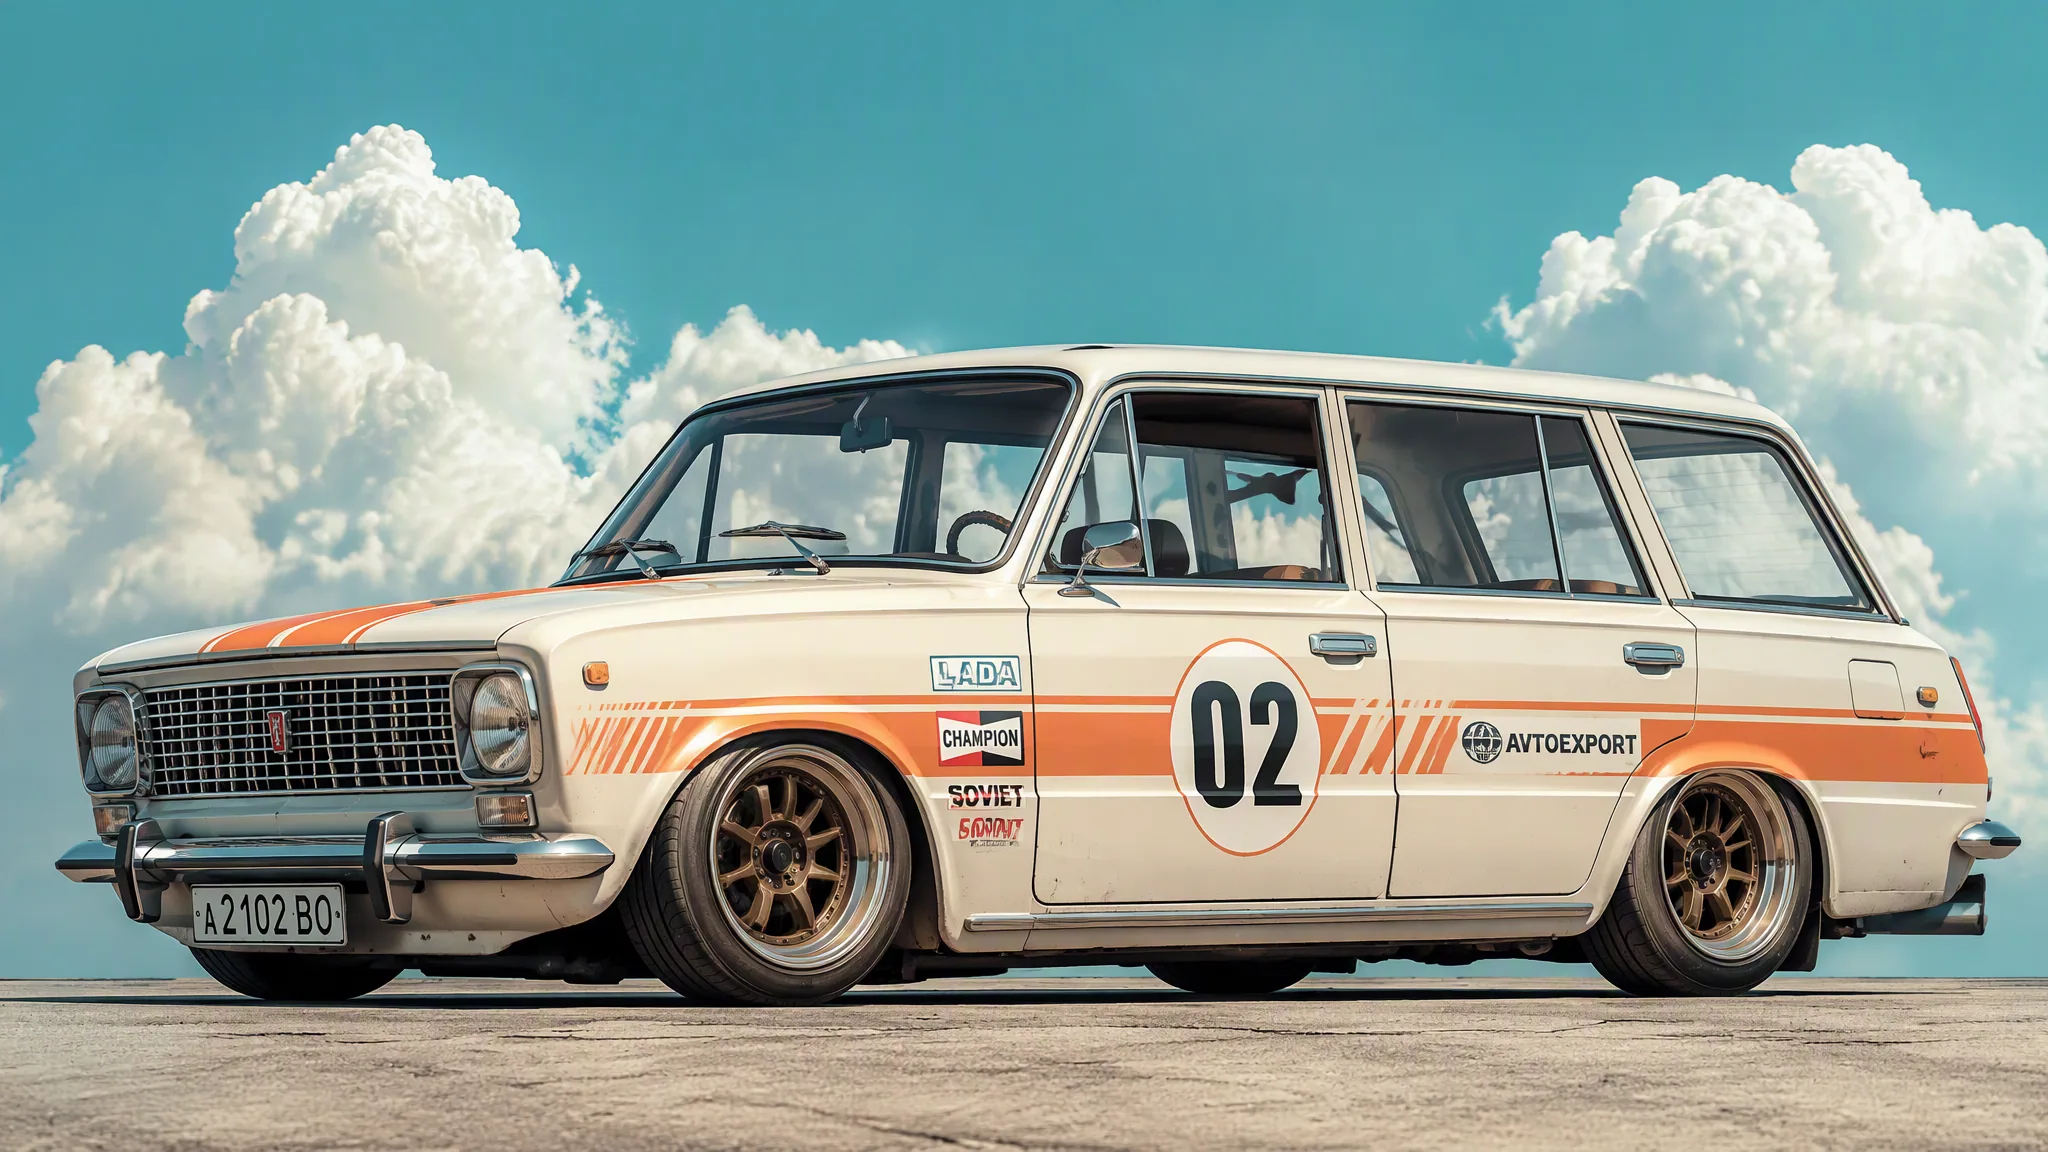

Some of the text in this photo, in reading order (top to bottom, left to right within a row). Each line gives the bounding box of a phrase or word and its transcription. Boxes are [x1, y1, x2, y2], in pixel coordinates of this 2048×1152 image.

[938, 661, 1018, 686] LADA
[943, 729, 1019, 748] CHAMPION
[1191, 680, 1302, 808] 02
[1505, 733, 1637, 755] AVTOEXPORT
[948, 785, 1024, 807] SOVIET
